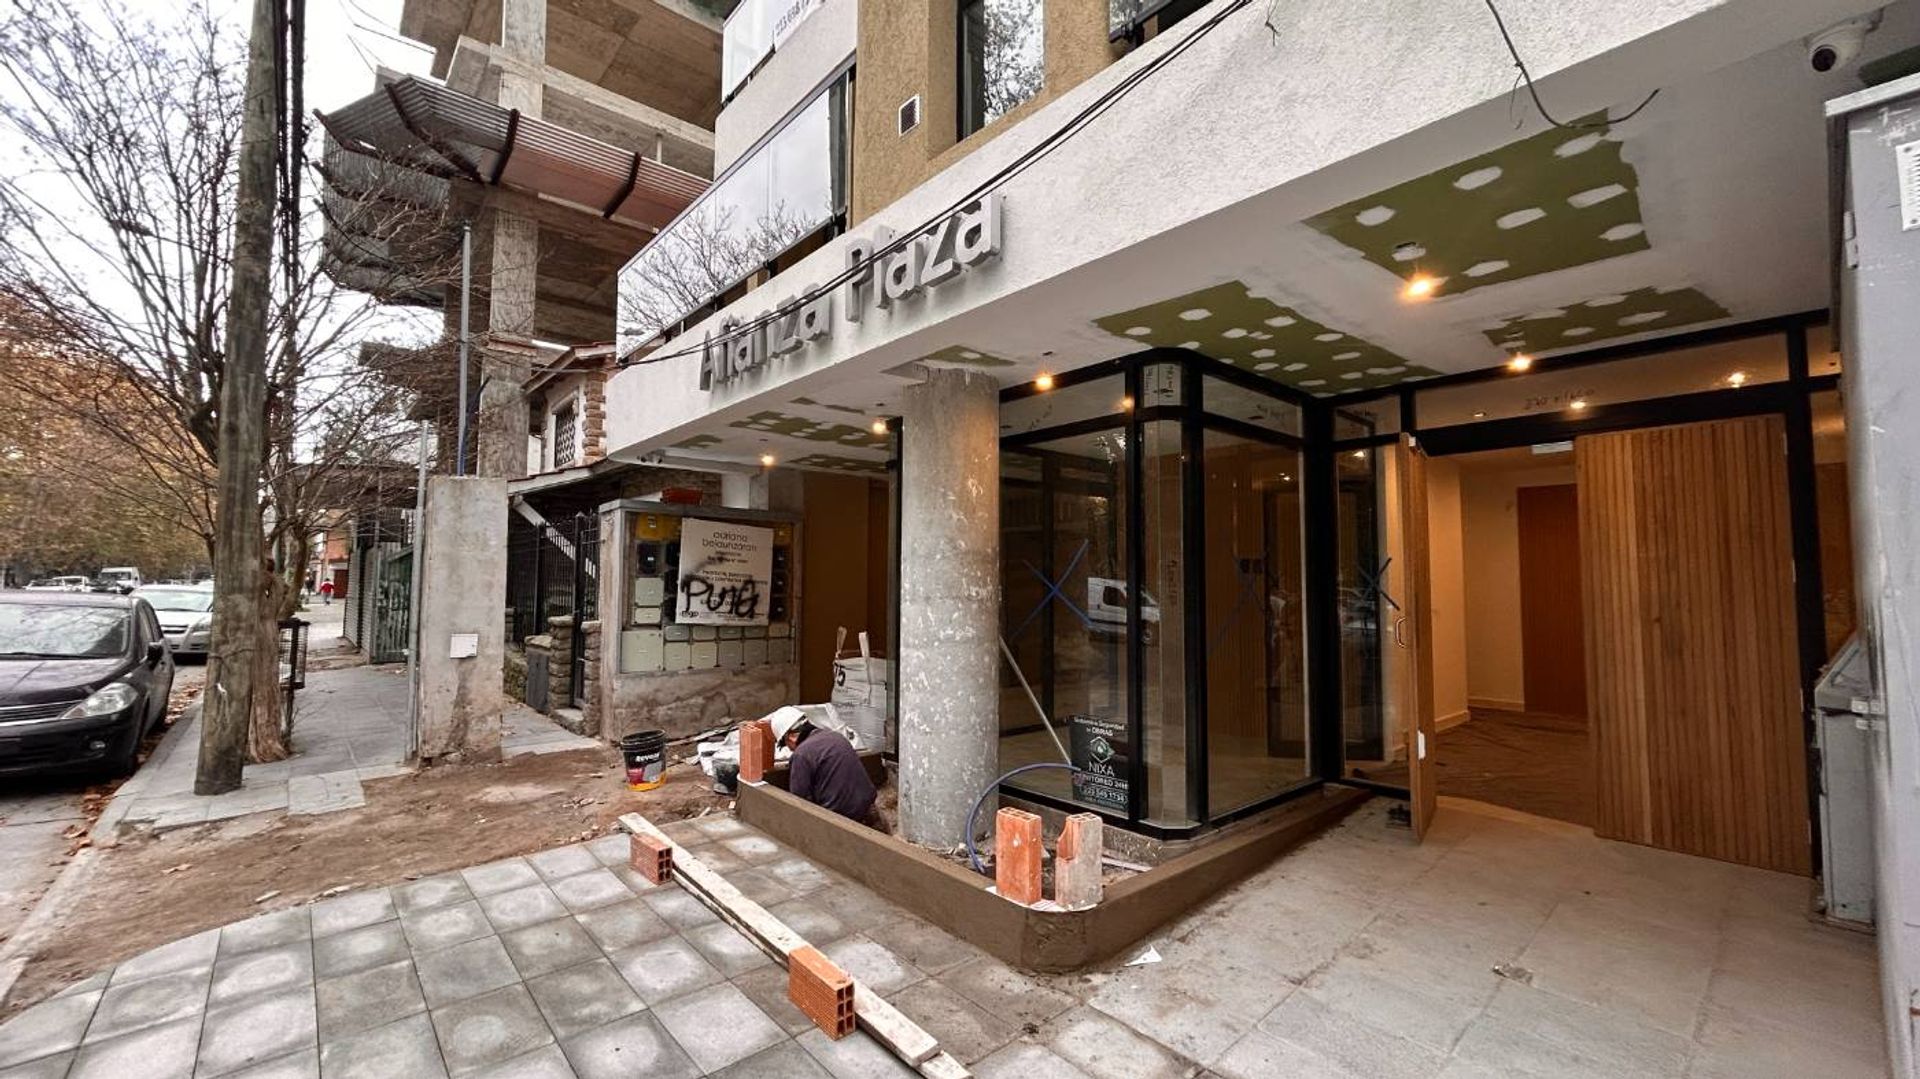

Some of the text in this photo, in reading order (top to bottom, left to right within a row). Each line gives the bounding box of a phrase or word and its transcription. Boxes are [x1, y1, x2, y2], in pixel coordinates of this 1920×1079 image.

[700, 192, 1002, 391] Alianza Plaza
[1088, 761, 1115, 777] NIXA
